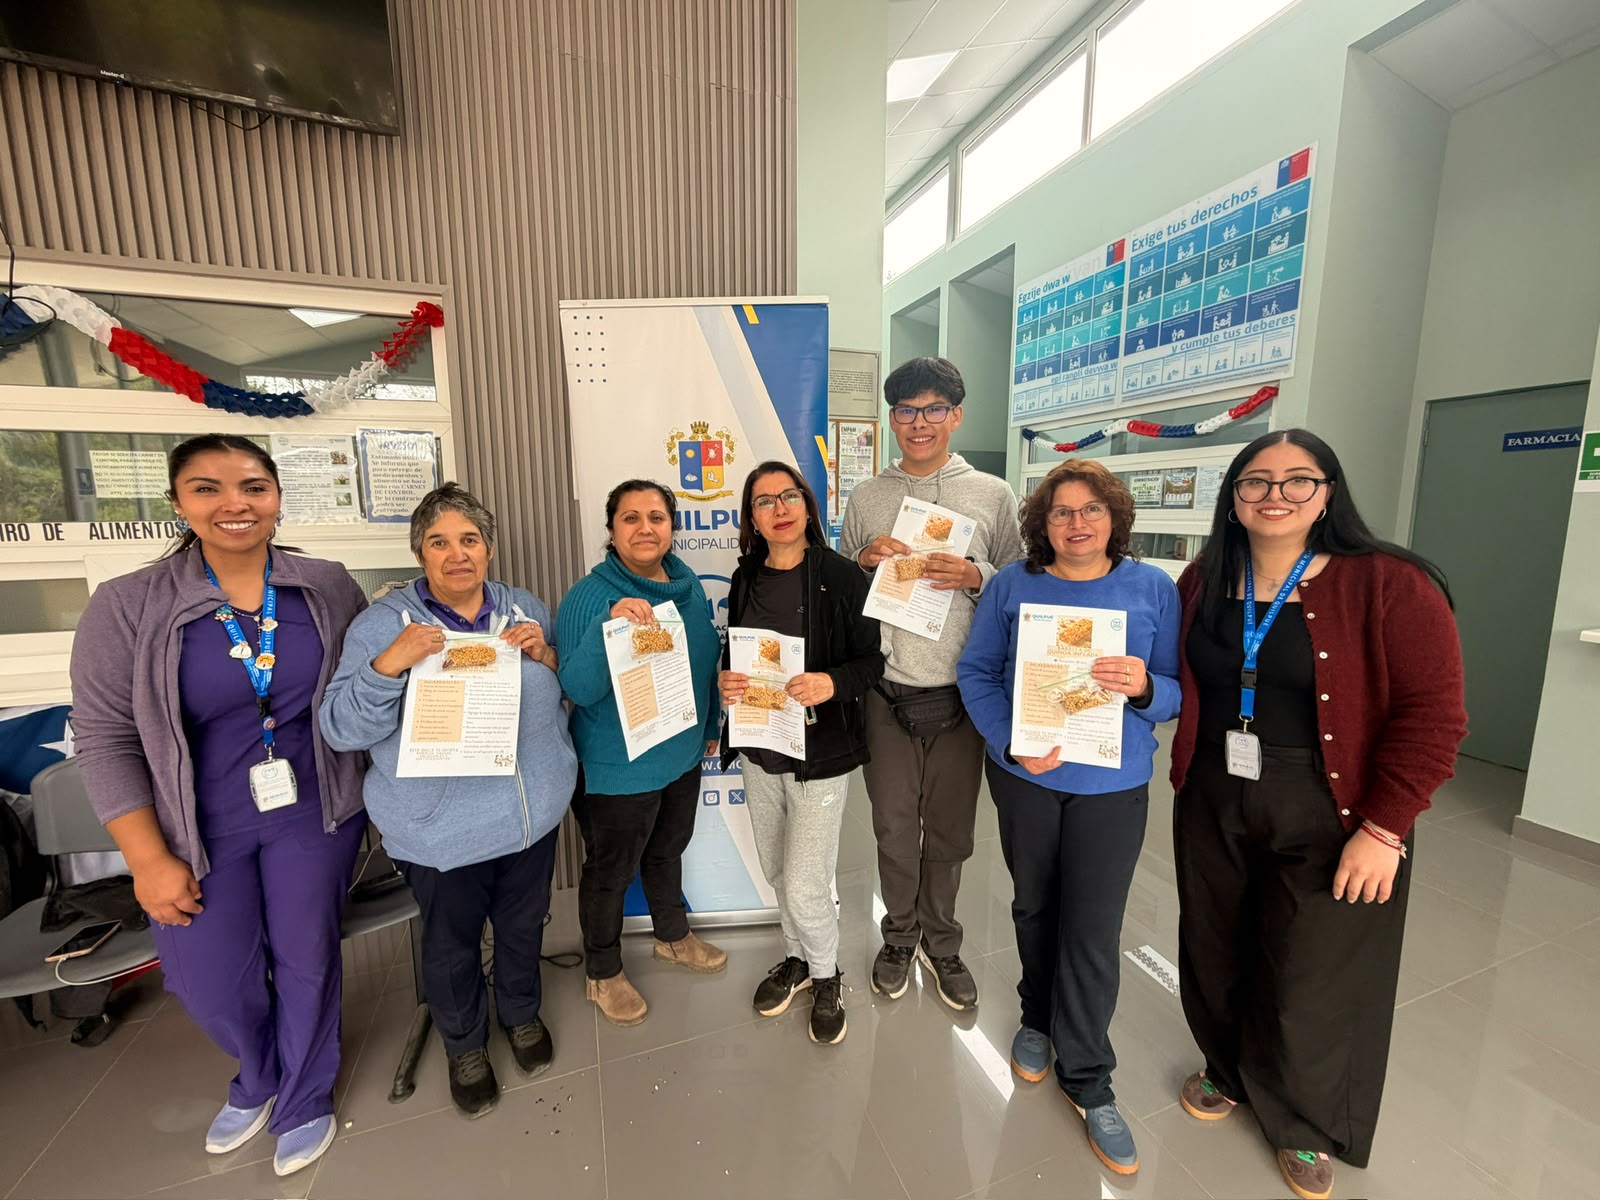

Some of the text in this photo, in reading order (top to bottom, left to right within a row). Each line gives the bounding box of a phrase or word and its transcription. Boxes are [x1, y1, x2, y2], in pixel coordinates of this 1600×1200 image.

[1131, 185, 1258, 252] Exige tus derechos
[1018, 274, 1071, 304] Egzije dwa w
[1180, 334, 1220, 351] cumple
[1223, 328, 1241, 340] tus
[1244, 313, 1296, 335] deberes
[1507, 433, 1582, 446] FARMACIA
[674, 509, 741, 531] UILPU
[0, 523, 31, 542] IRO
[42, 523, 65, 541] DE
[673, 537, 741, 550] NICIPALID
[266, 585, 274, 615] UNICIPAL
[227, 623, 242, 644] QUILP
